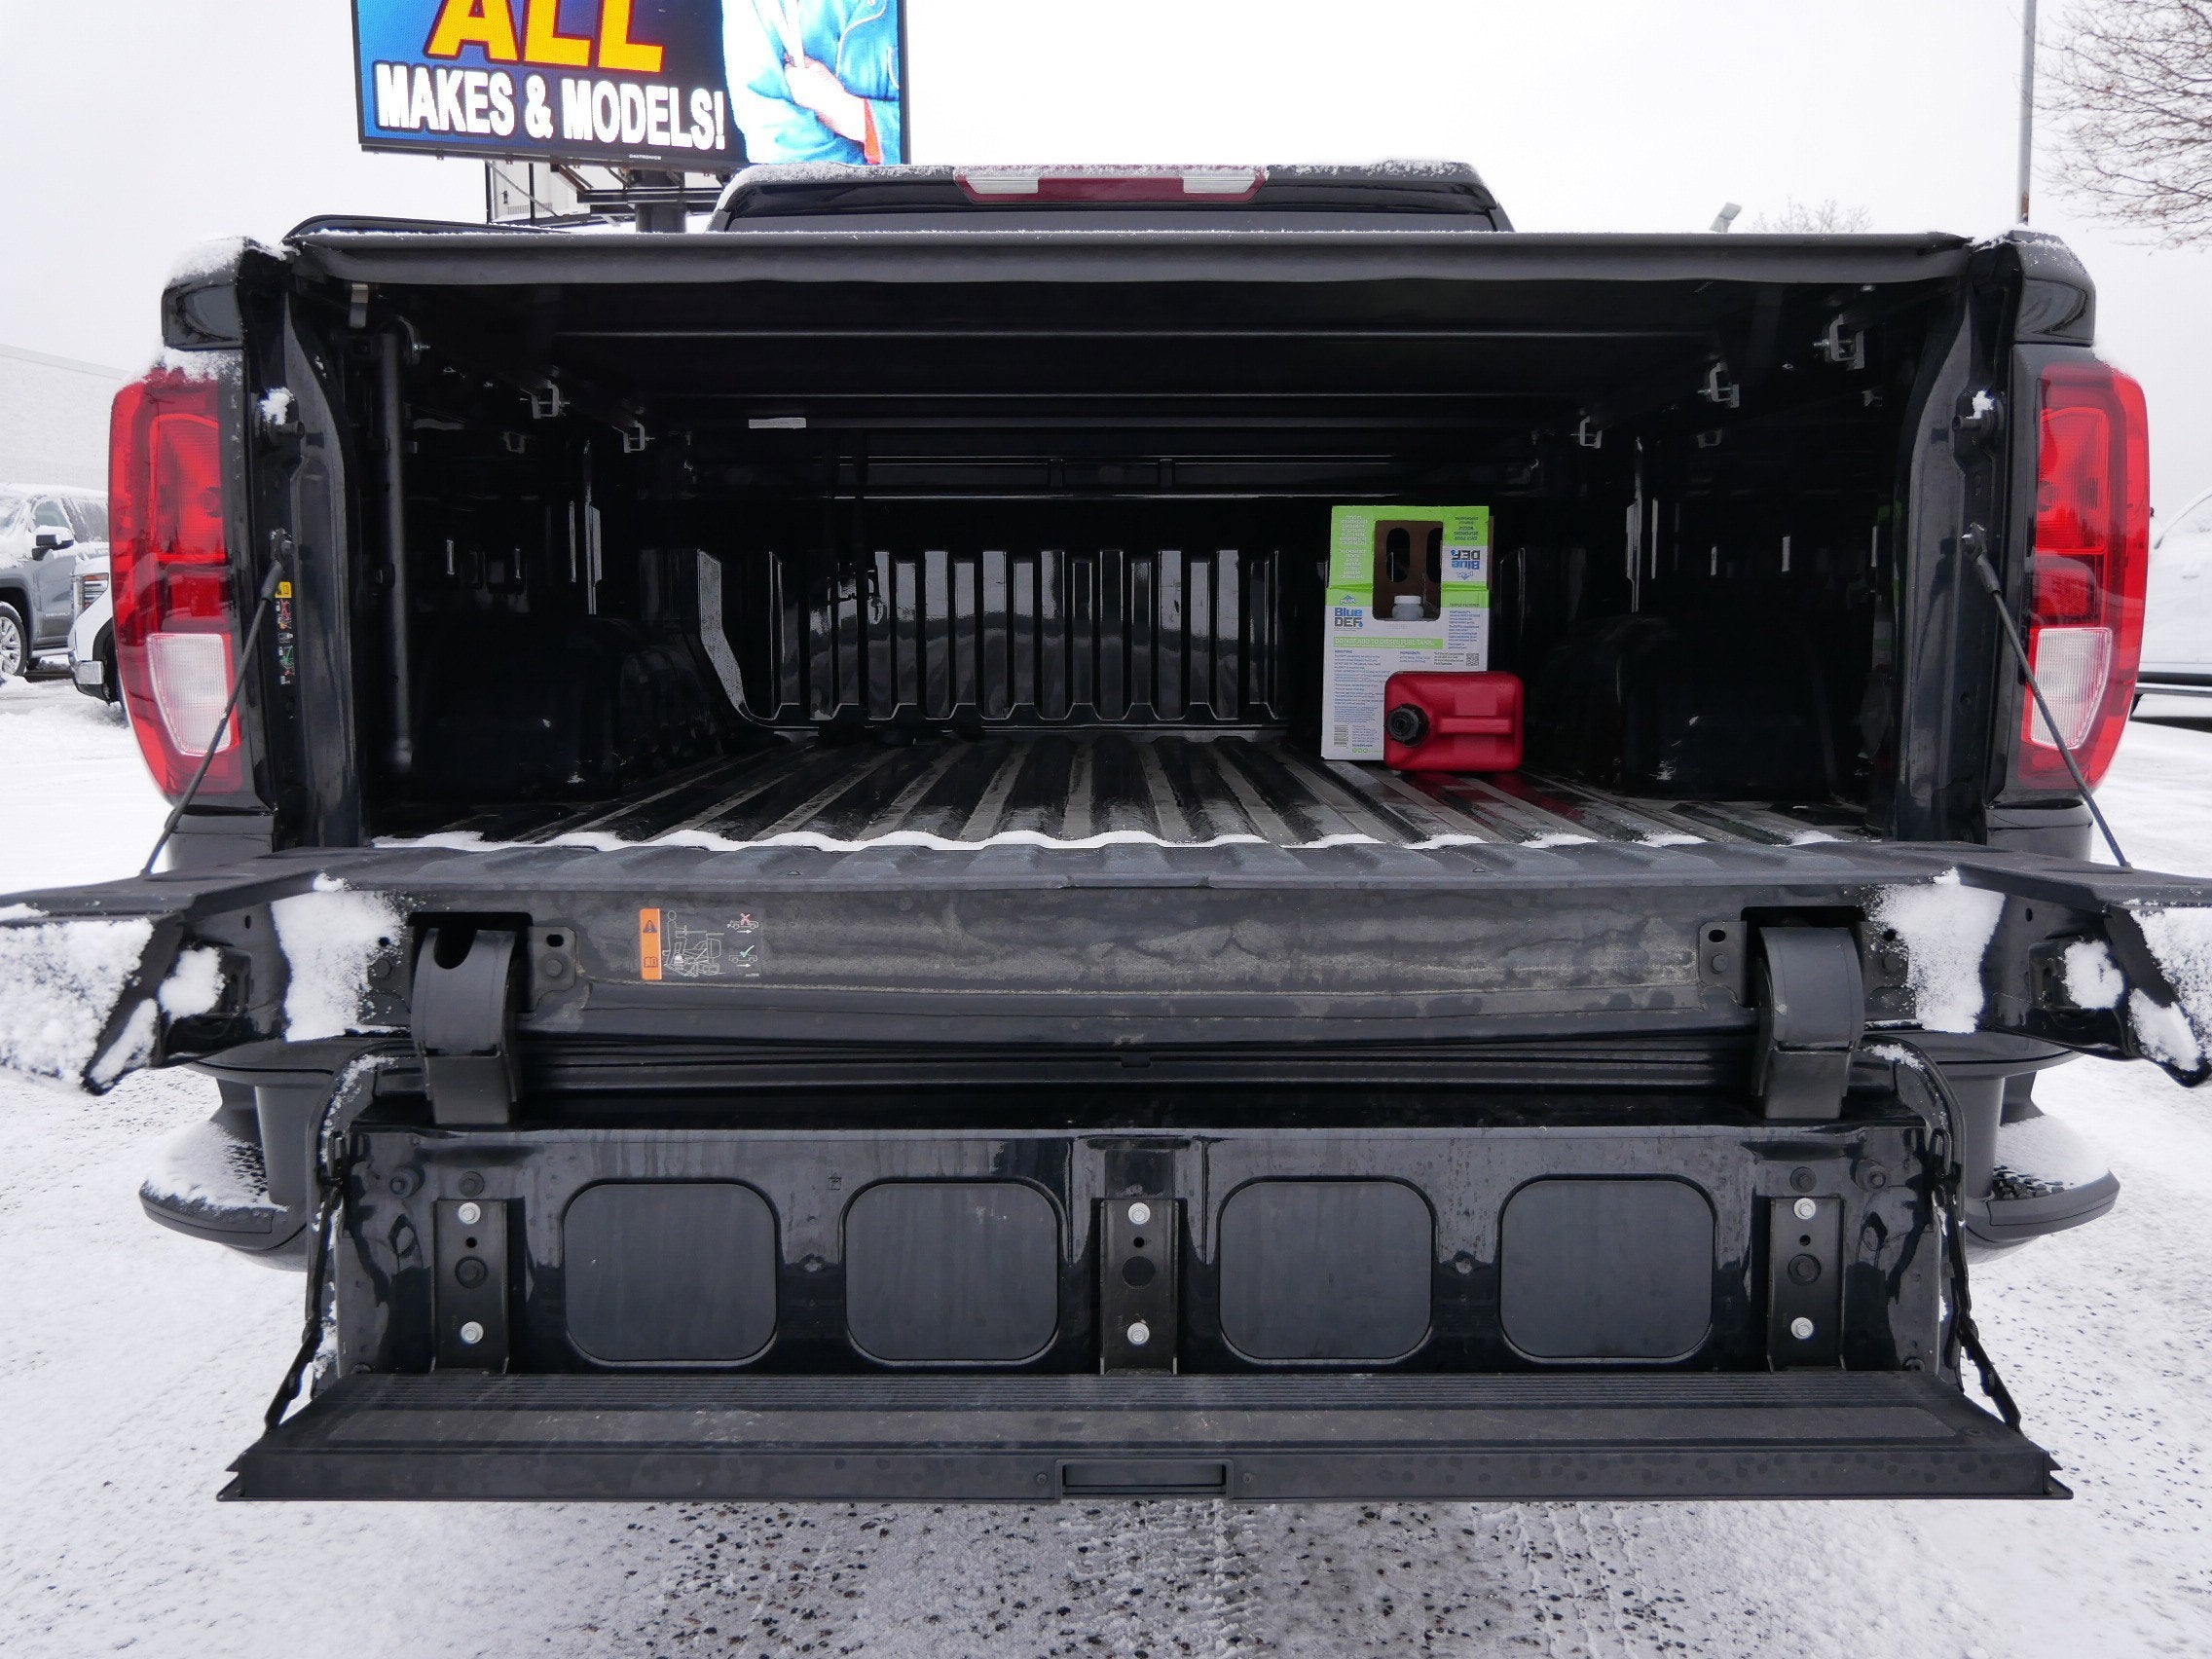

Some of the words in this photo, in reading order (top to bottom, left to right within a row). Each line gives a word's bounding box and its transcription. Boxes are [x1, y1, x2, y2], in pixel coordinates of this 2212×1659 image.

[426, 0, 664, 74] ALL
[374, 63, 516, 137] MAKES
[524, 73, 554, 140] &
[561, 78, 725, 151] MODELS!
[1451, 549, 1481, 561] DEF
[1451, 560, 1481, 571] Blue
[1334, 607, 1363, 617] Blue
[1334, 616, 1363, 628] DEF
